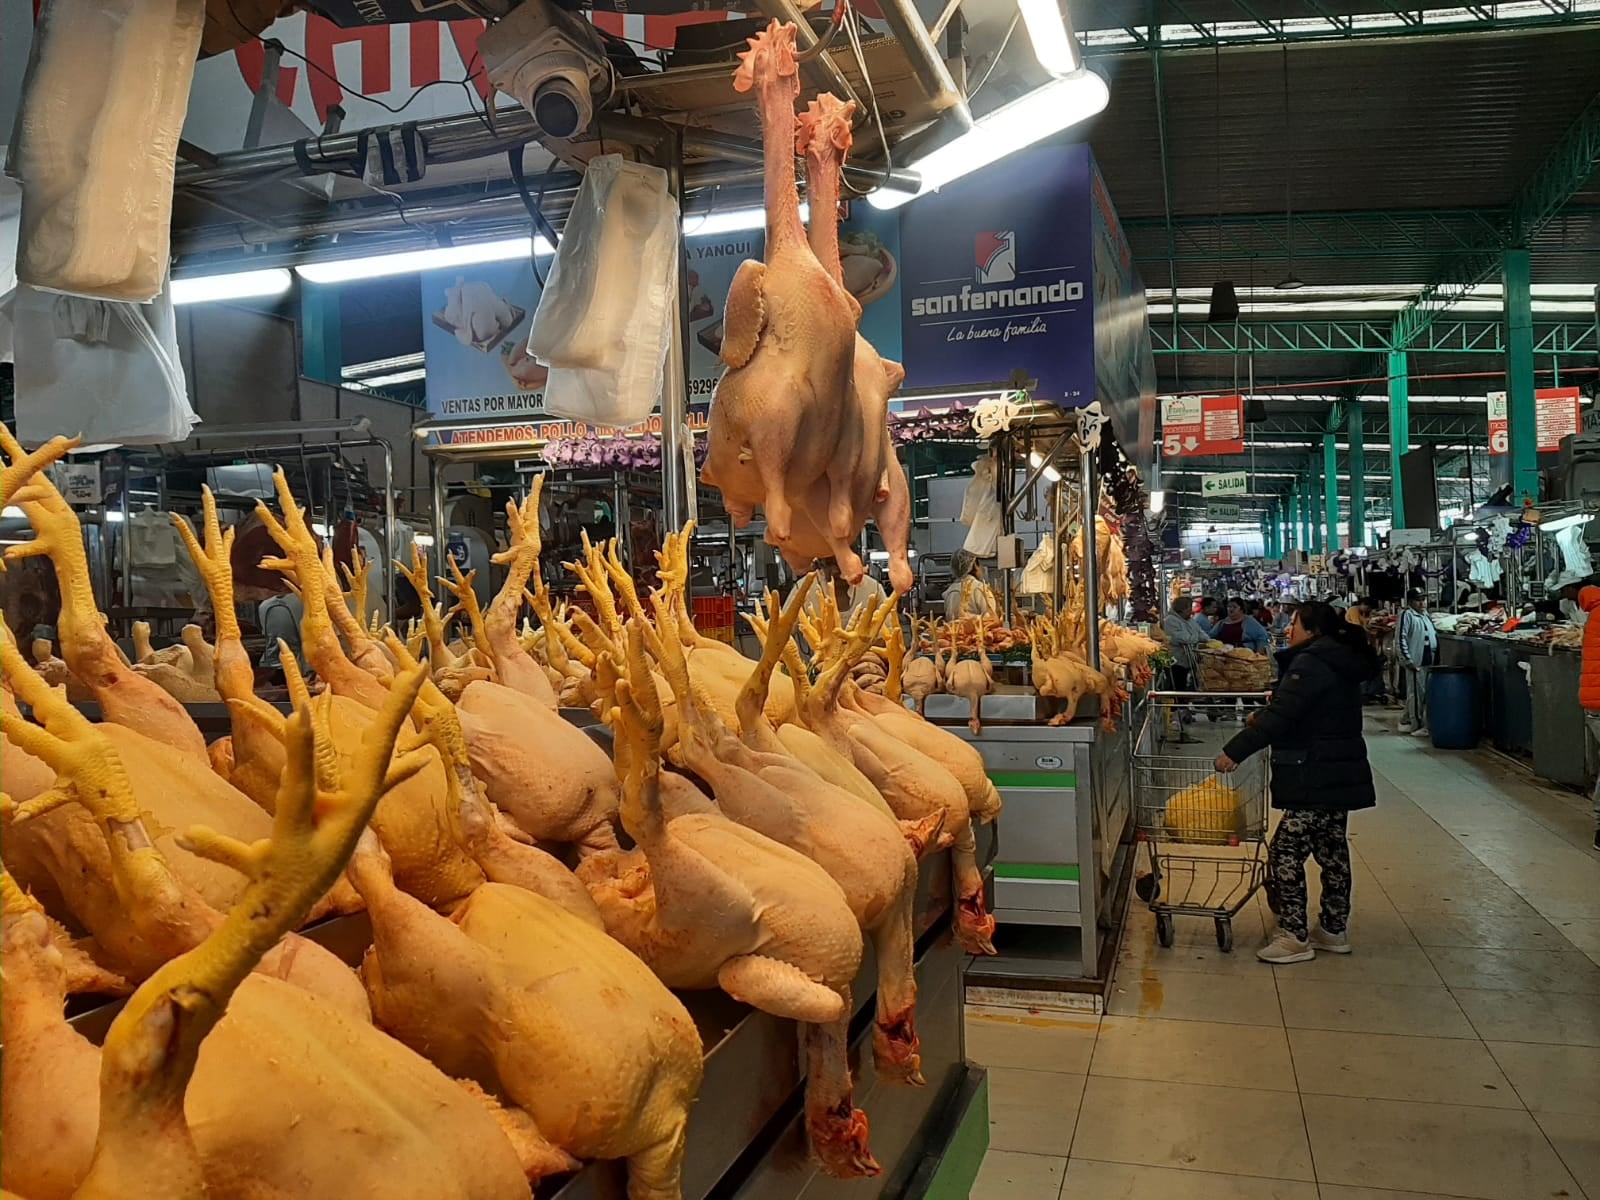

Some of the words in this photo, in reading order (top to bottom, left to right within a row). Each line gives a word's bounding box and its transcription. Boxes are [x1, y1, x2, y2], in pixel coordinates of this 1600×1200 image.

[696, 242, 751, 259] YANQUI
[947, 326, 965, 342] La
[966, 324, 1001, 340] buena
[1003, 316, 1047, 342] familia
[441, 397, 481, 414] VENTAS
[484, 396, 505, 412] POR
[508, 393, 543, 409] MAYOR
[452, 425, 538, 445] ATENDEMOS:
[541, 420, 587, 440] POLLO
[1491, 429, 1508, 453] 6
[1164, 434, 1181, 455] 5
[1218, 478, 1244, 490] SALIDA
